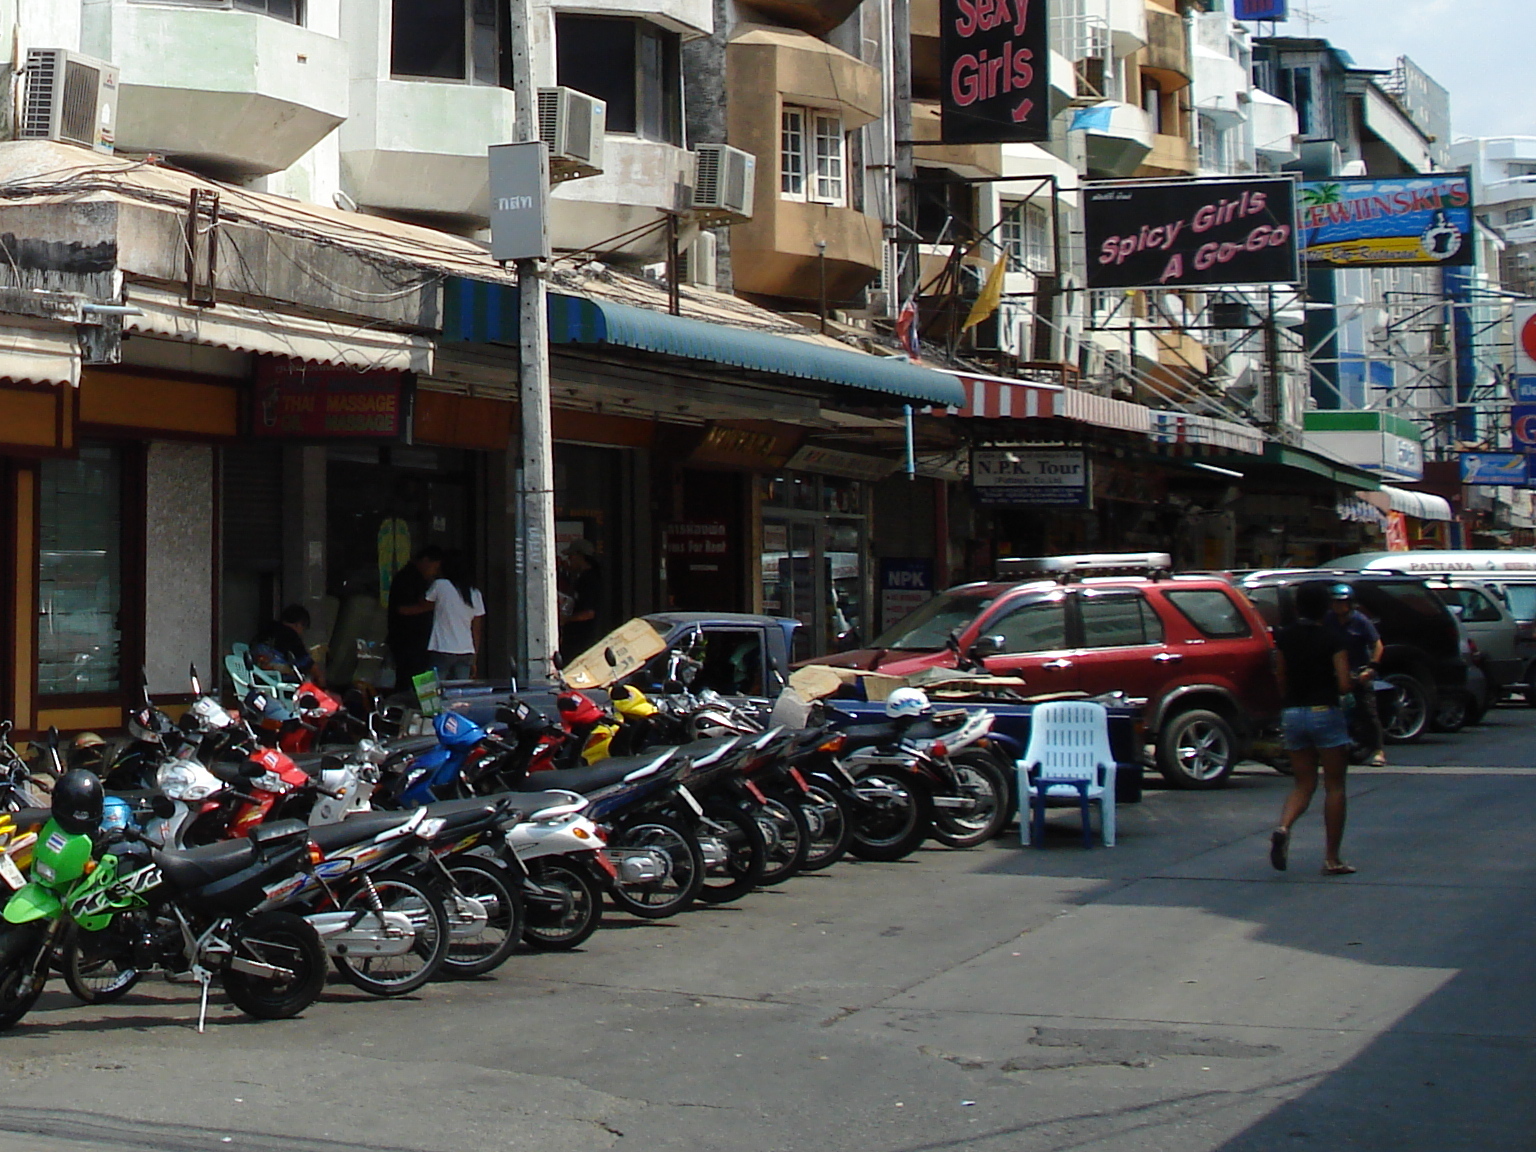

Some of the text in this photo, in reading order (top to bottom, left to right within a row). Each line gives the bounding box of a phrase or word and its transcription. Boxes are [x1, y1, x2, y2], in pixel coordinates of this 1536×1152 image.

[951, 40, 1034, 107] Girls
[1098, 190, 1268, 265] Spicy Girls
[1159, 224, 1291, 284] A Go-Go
[282, 394, 396, 412] THAI MASSAGE
[325, 414, 395, 432] MASSAGE
[1037, 460, 1081, 475] Tour
[1410, 562, 1476, 571] PATTAYA
[888, 570, 925, 587] NPK
